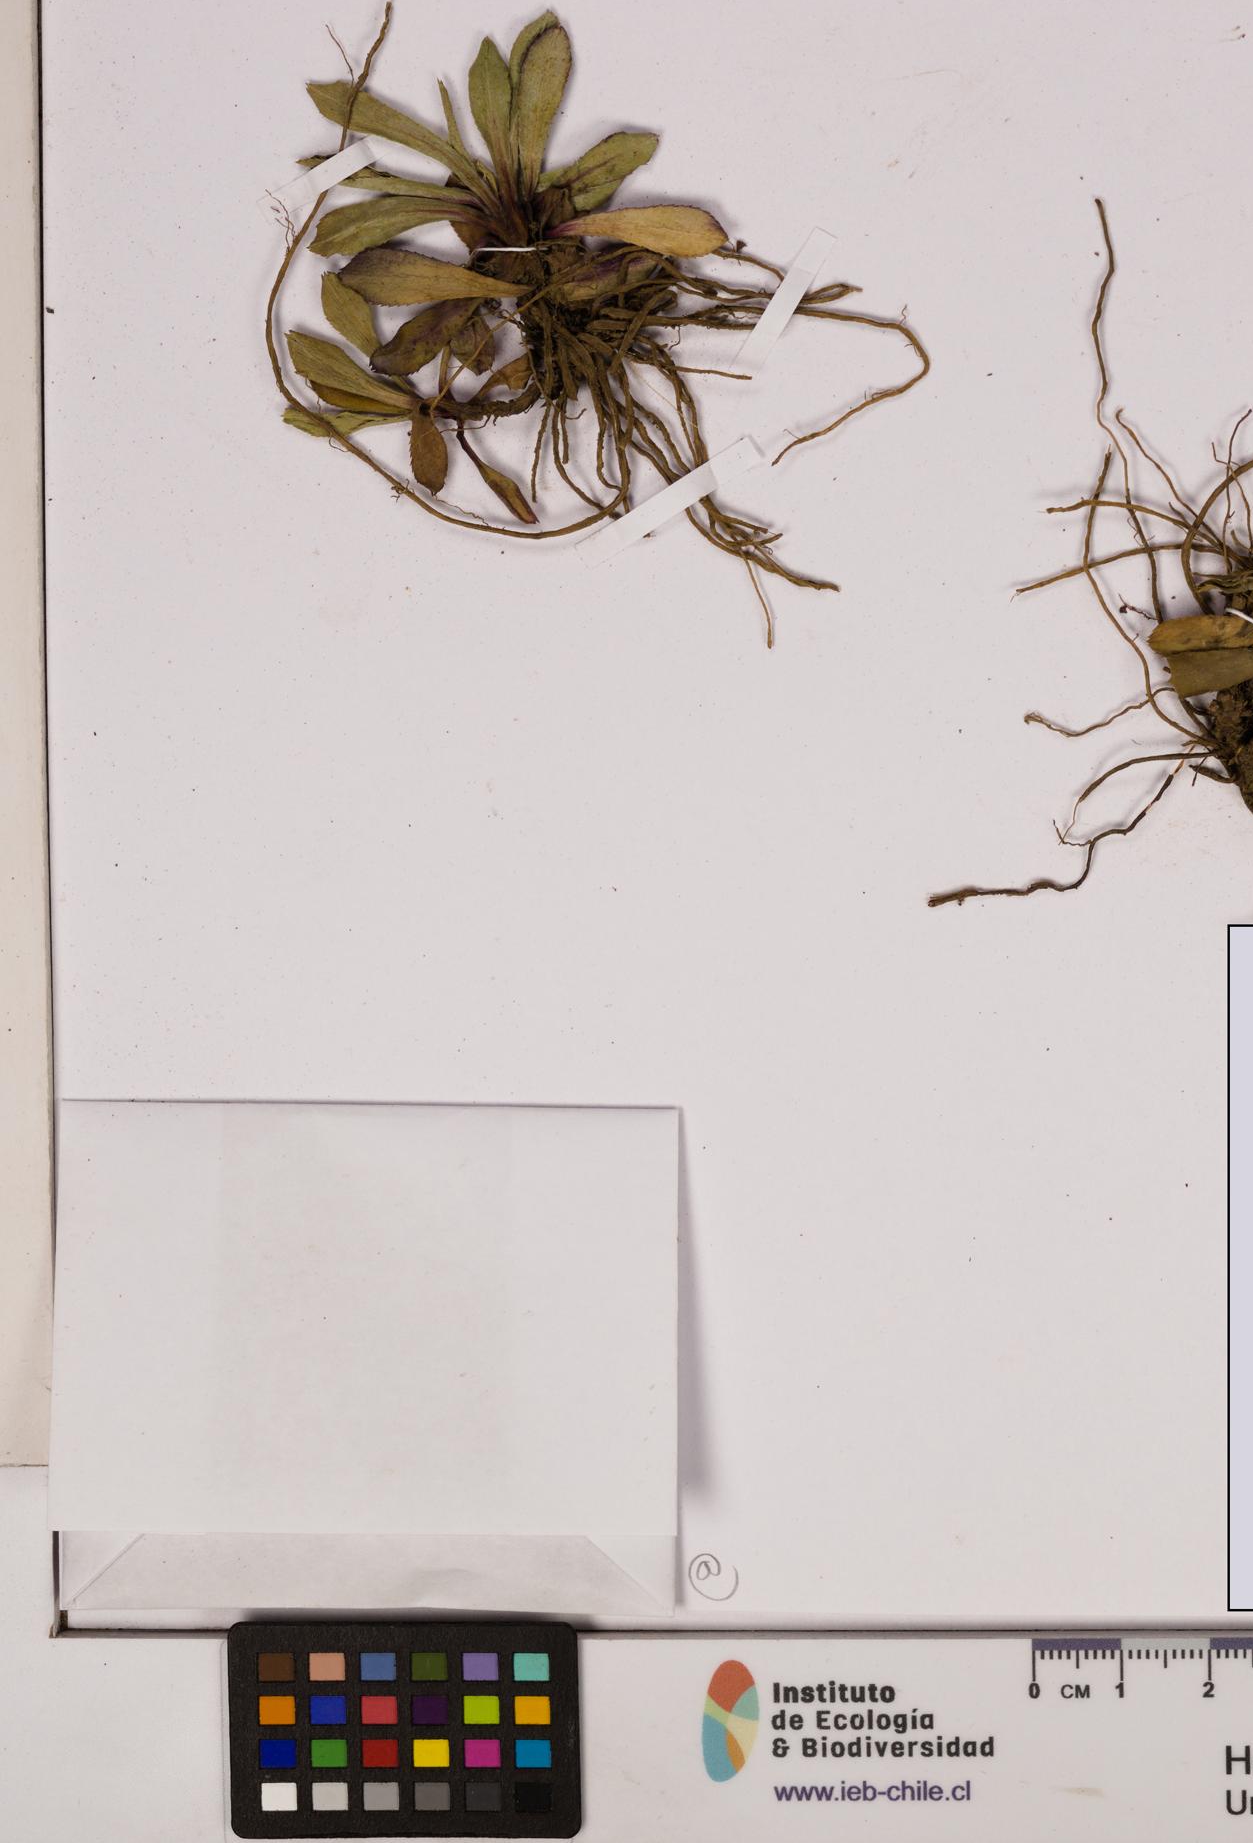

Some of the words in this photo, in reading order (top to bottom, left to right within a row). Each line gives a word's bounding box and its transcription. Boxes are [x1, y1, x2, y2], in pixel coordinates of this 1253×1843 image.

[773, 1680, 895, 1703] Instituto
[1028, 1683, 1040, 1699] 0
[1060, 1684, 1090, 1699] CM
[1115, 1682, 1124, 1698] 1
[1202, 1682, 1215, 1698] 2
[771, 1710, 803, 1730] de
[816, 1708, 934, 1734] Ecología
[772, 1738, 790, 1758] &
[802, 1736, 994, 1758] Biodiversidad
[774, 1780, 970, 1801] www.ieb-chile.cl
